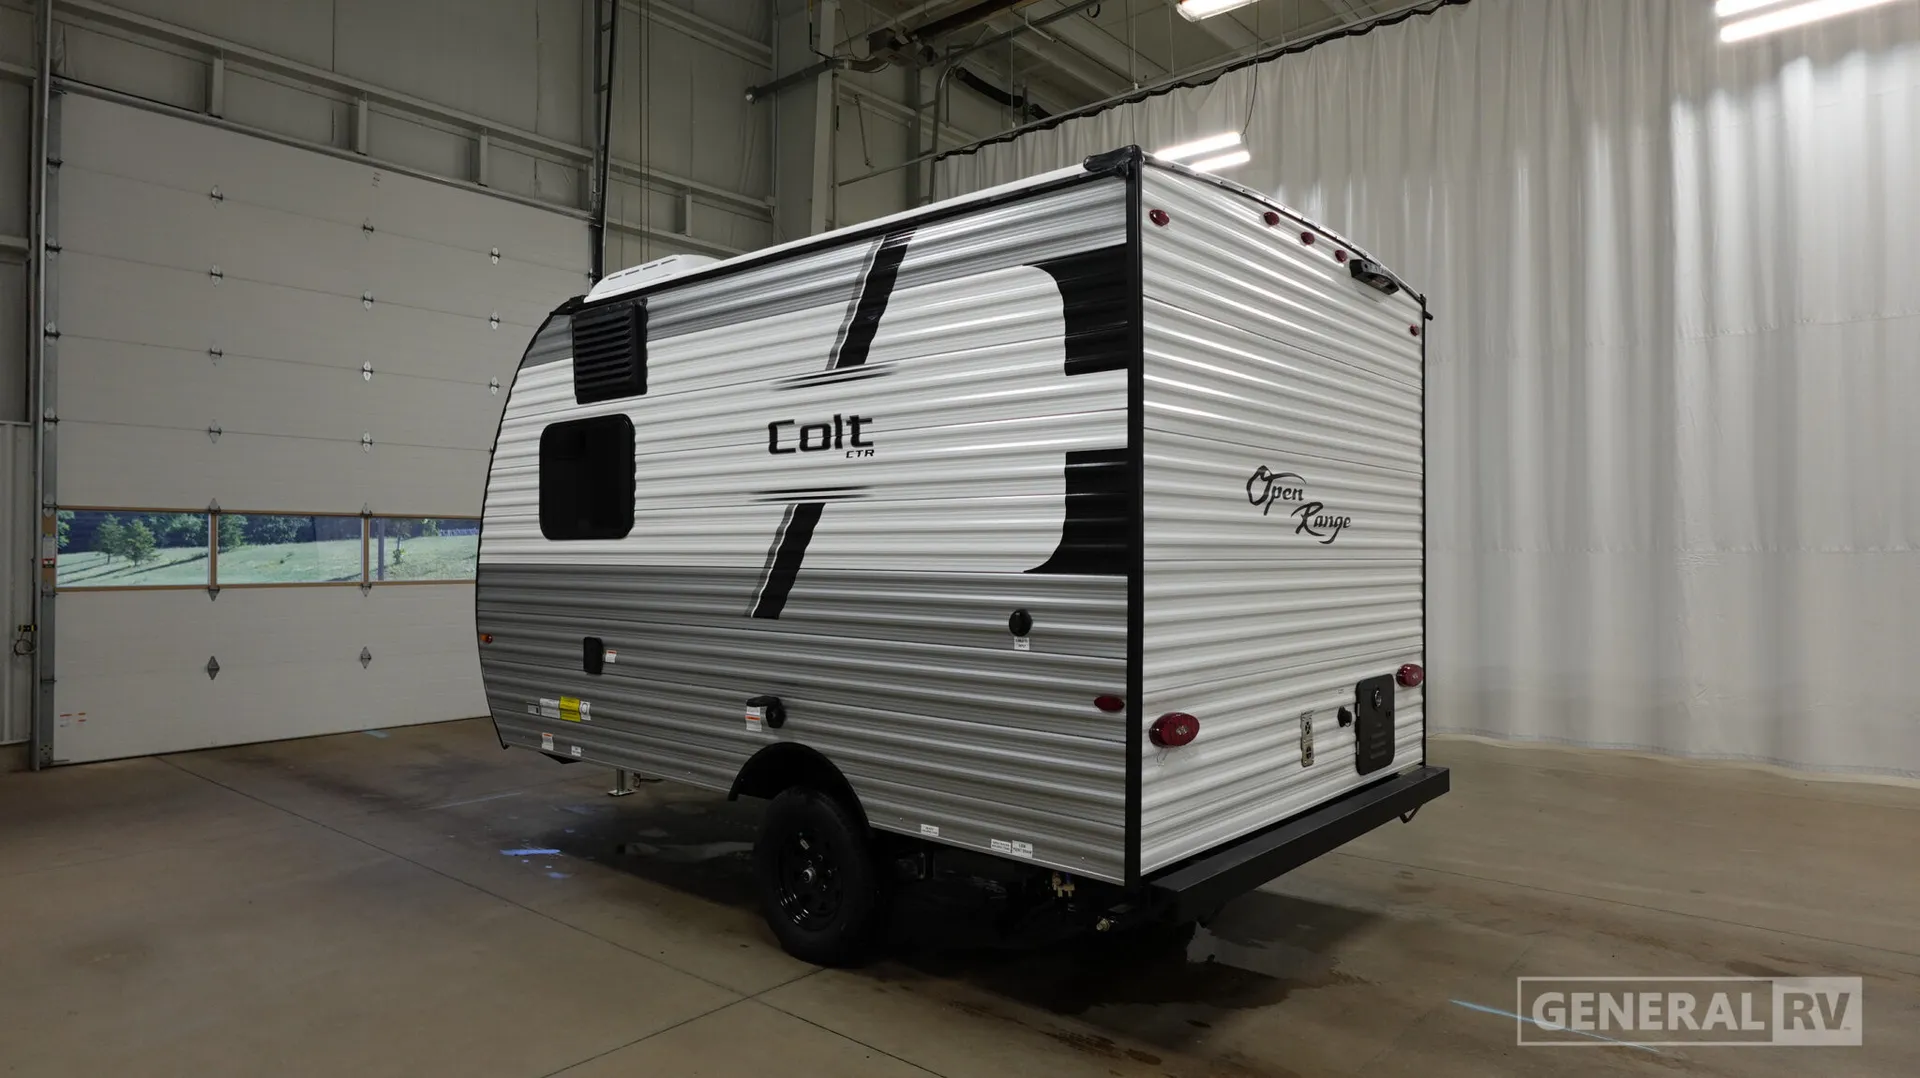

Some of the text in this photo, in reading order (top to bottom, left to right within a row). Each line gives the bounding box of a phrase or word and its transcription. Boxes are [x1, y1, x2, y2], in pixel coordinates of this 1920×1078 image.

[768, 413, 874, 455] Colt
[845, 449, 875, 459] CTR
[1246, 465, 1306, 516] Open
[1291, 502, 1351, 544] Range
